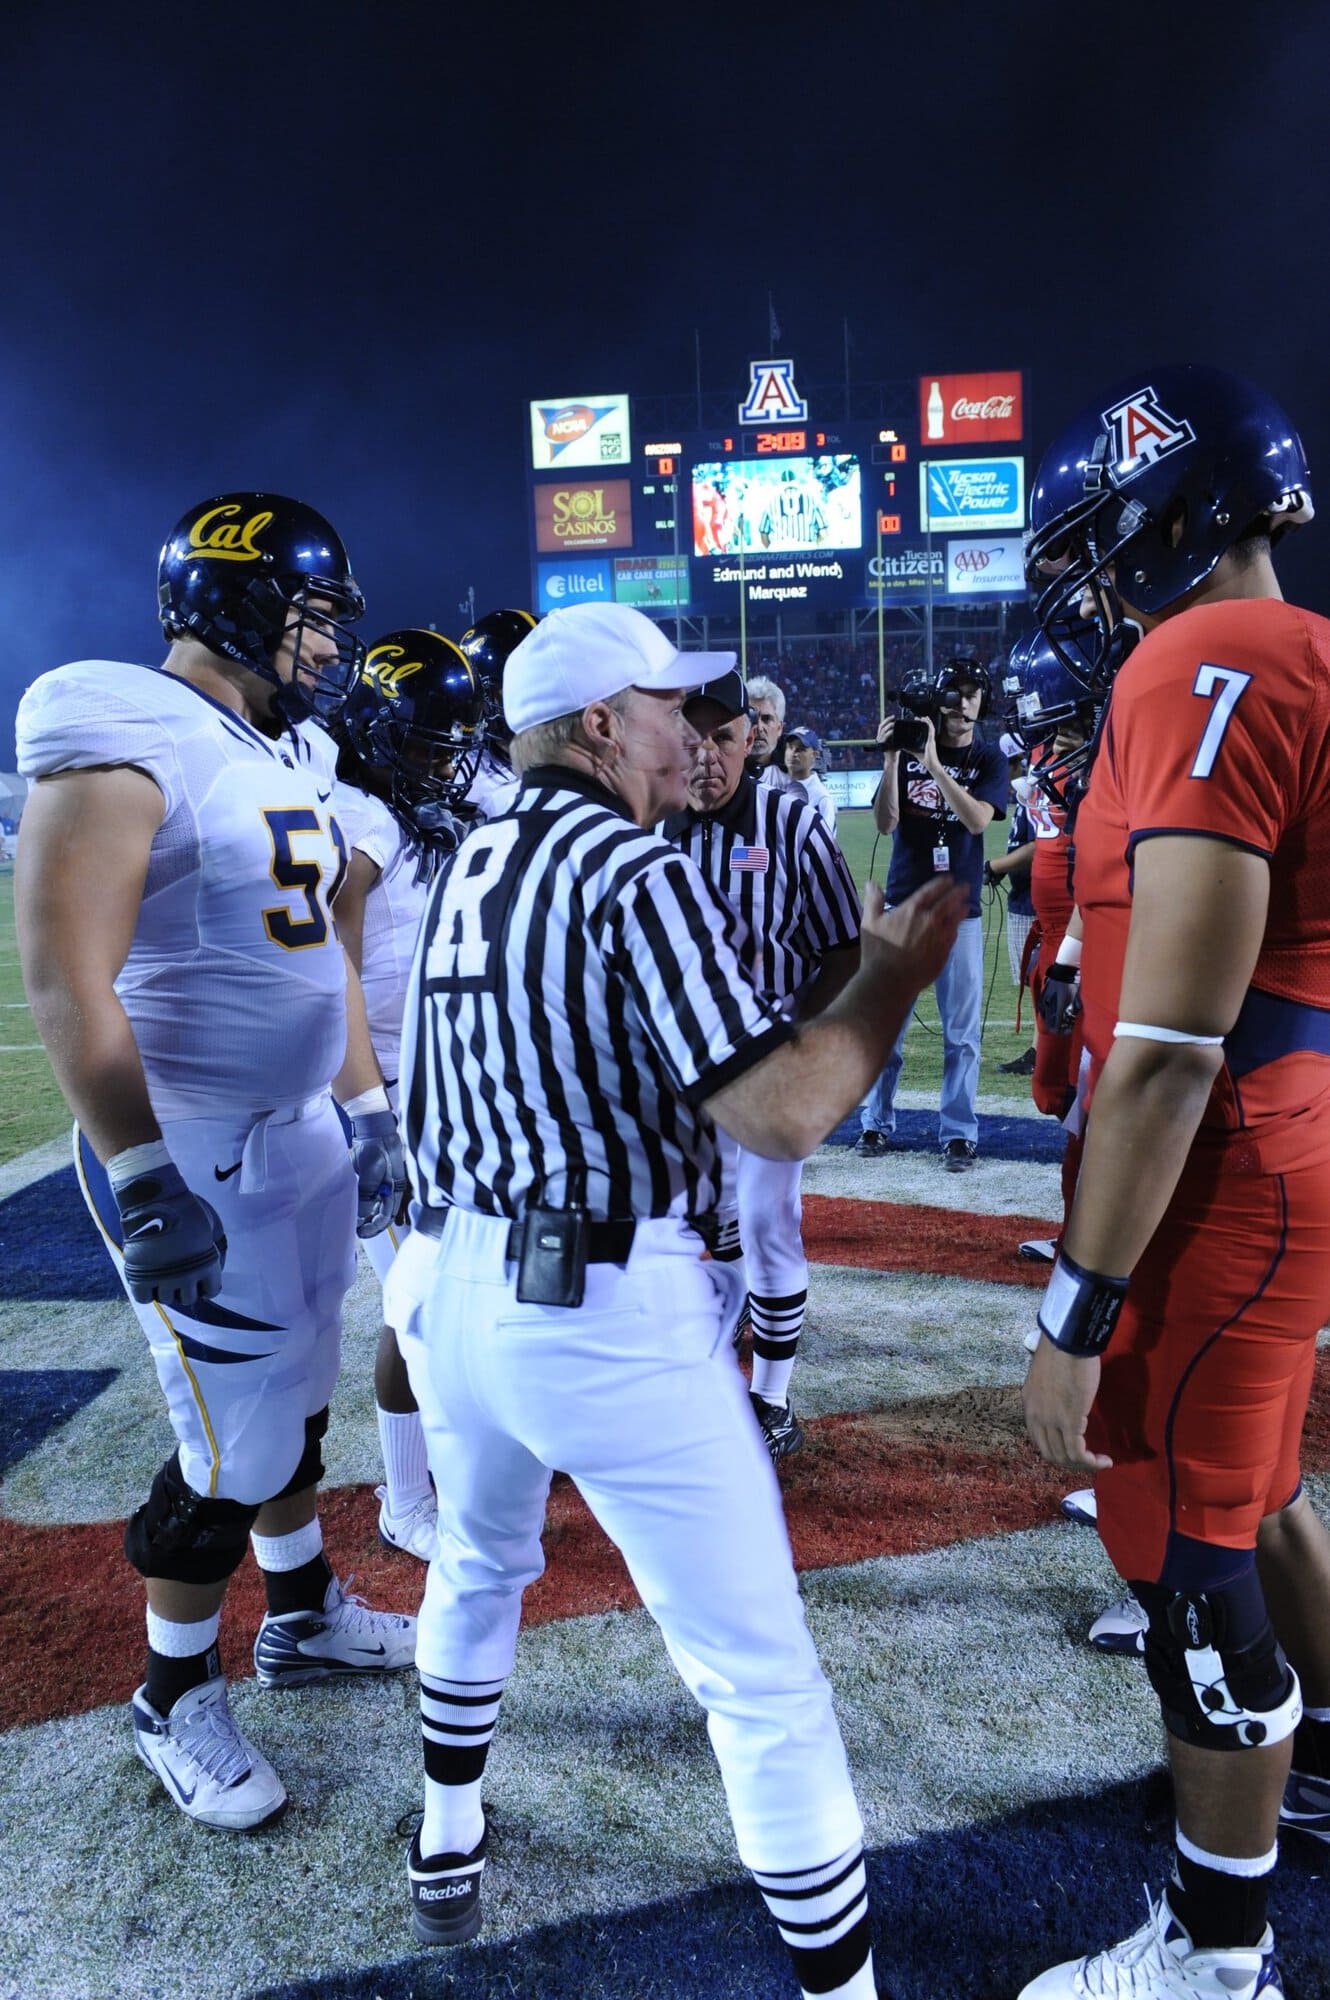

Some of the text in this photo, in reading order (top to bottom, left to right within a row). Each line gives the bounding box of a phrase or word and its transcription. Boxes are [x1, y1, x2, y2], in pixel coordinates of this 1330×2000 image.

[739, 359, 808, 425] A
[951, 395, 1016, 421] Coca-Cola
[1101, 386, 1197, 489] A
[949, 470, 997, 485] Tucson
[953, 481, 1010, 496] Electric
[553, 489, 615, 522] SOL
[959, 496, 1009, 510] Power
[184, 504, 273, 561] Cal
[553, 519, 617, 537] CASINOS
[904, 550, 943, 560] Tucson
[713, 562, 843, 582] Edmund and Wendy
[868, 556, 945, 577] Citizen
[972, 574, 1021, 584] Insurance
[749, 586, 807, 602] Marquez
[1192, 662, 1253, 779] 7
[425, 818, 520, 980] R
[418, 1879, 473, 1901] Reebok
